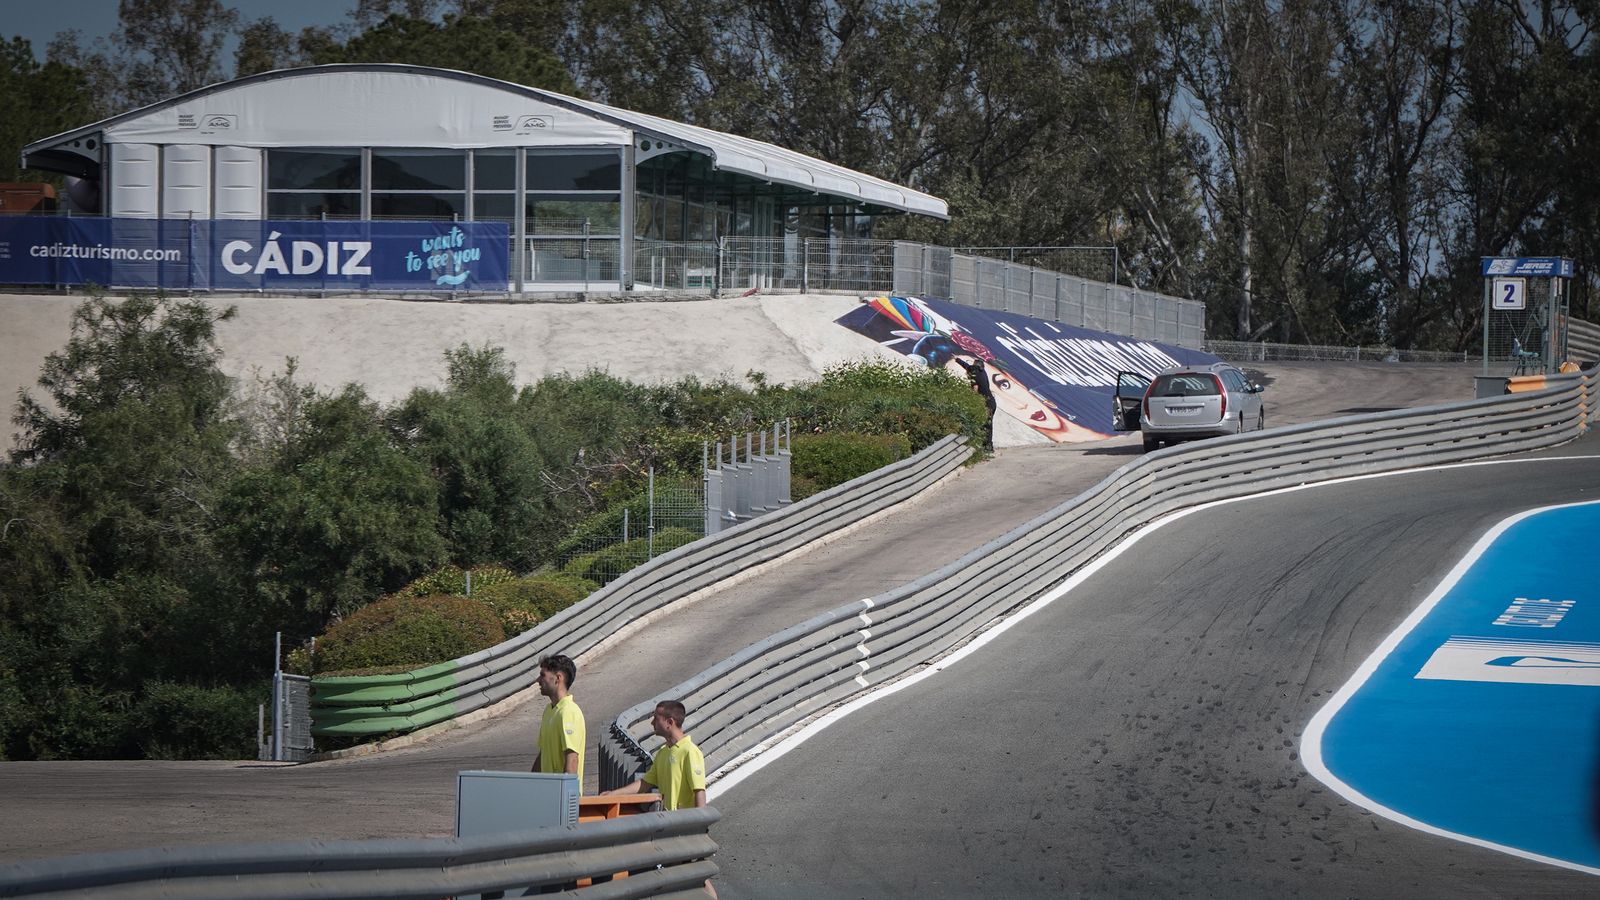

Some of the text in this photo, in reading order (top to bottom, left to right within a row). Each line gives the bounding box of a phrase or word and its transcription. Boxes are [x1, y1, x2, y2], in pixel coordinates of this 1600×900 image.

[30, 242, 181, 261] cadizturismo.com
[422, 226, 465, 252] wants
[221, 231, 371, 275] CÁDIZ
[405, 248, 481, 273] to see you
[1504, 284, 1515, 303] 2
[995, 322, 1181, 387] cadizturismocom
